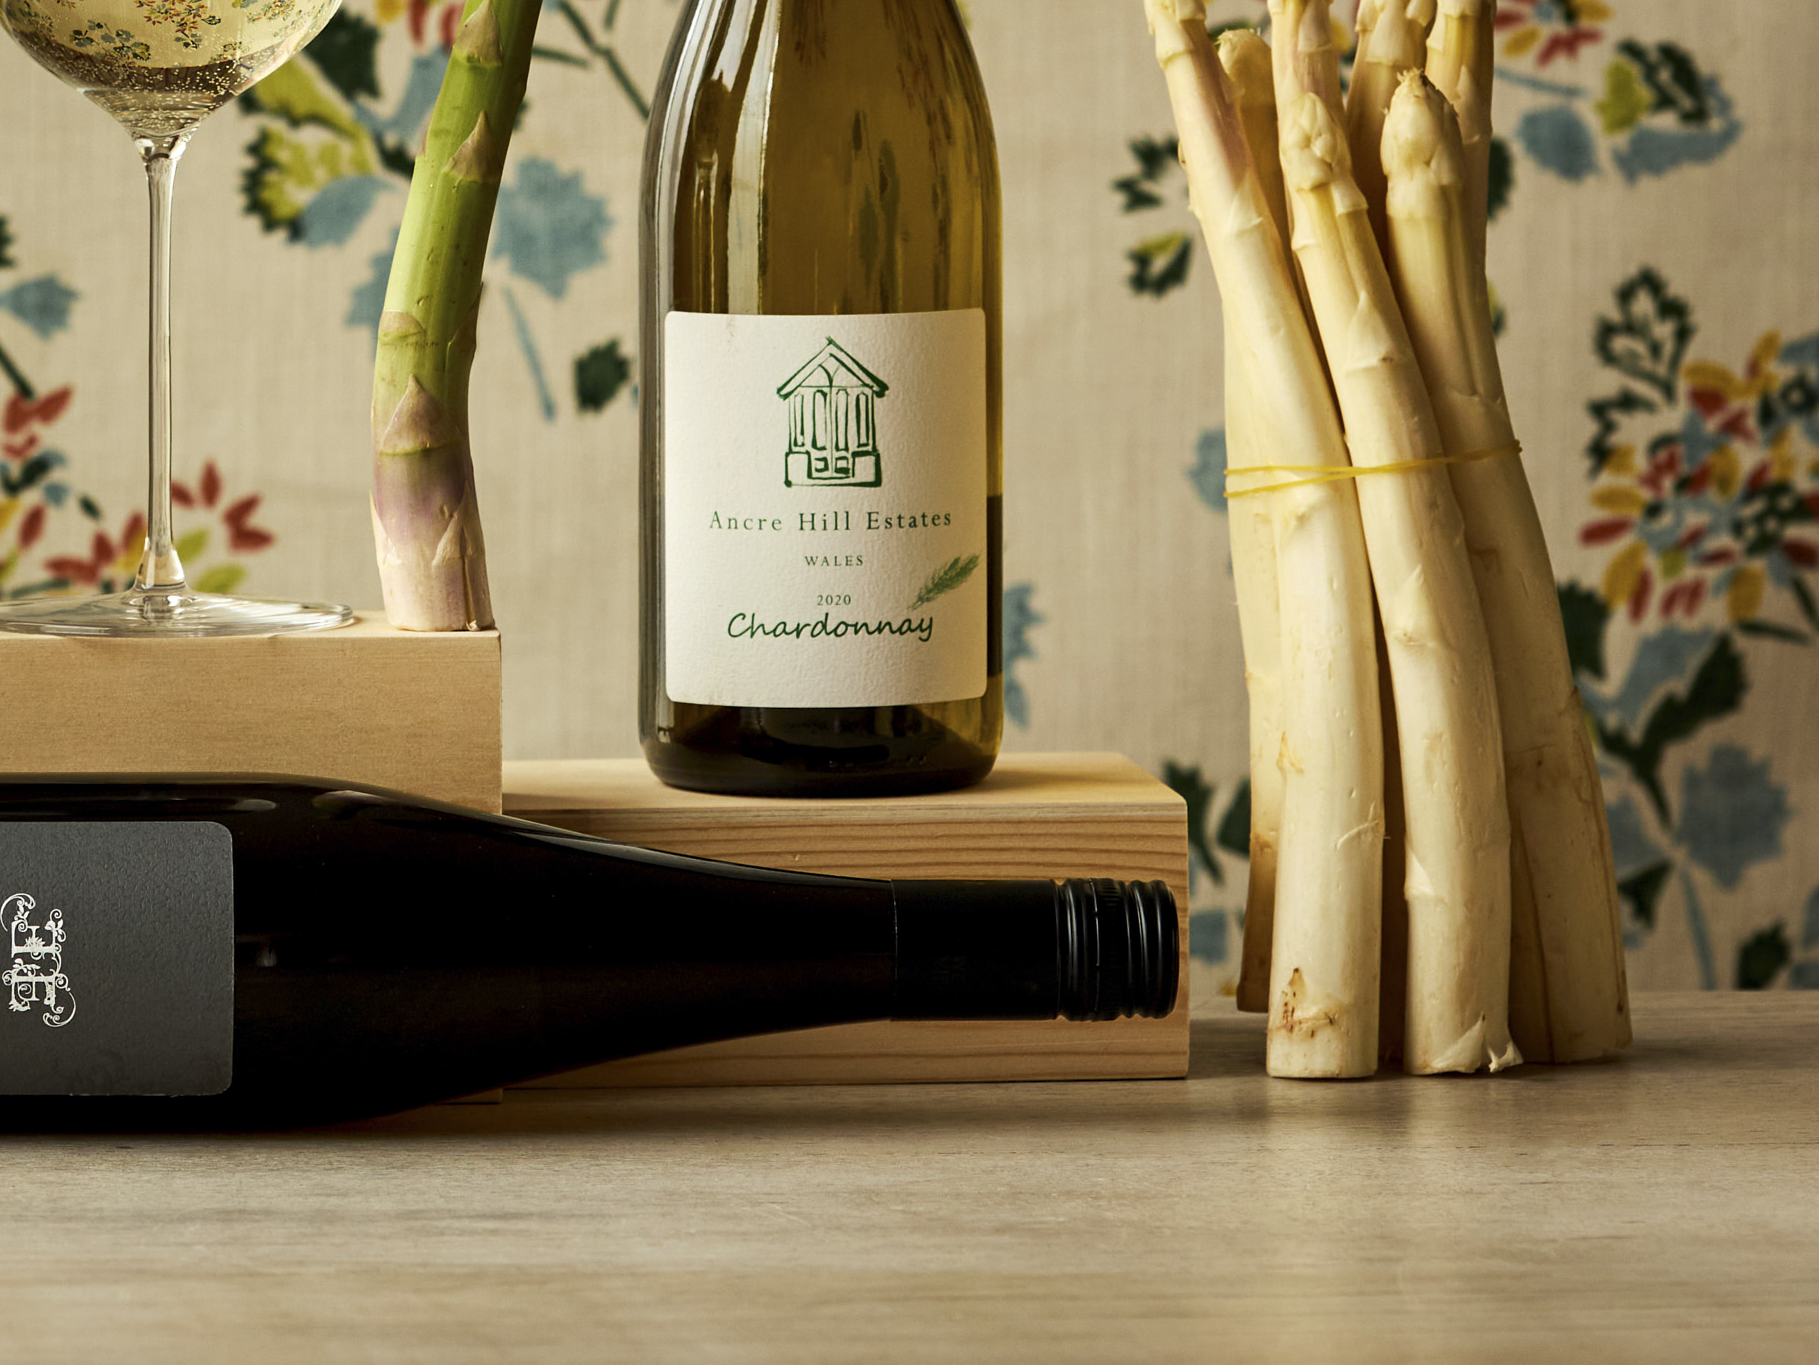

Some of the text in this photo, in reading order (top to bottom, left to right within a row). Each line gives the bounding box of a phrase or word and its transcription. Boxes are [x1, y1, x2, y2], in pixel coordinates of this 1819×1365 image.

[709, 510, 952, 531] Ancre Hill Estates
[804, 555, 864, 567] WALES
[816, 594, 852, 606] 2020
[727, 612, 933, 643] Chardonnay
